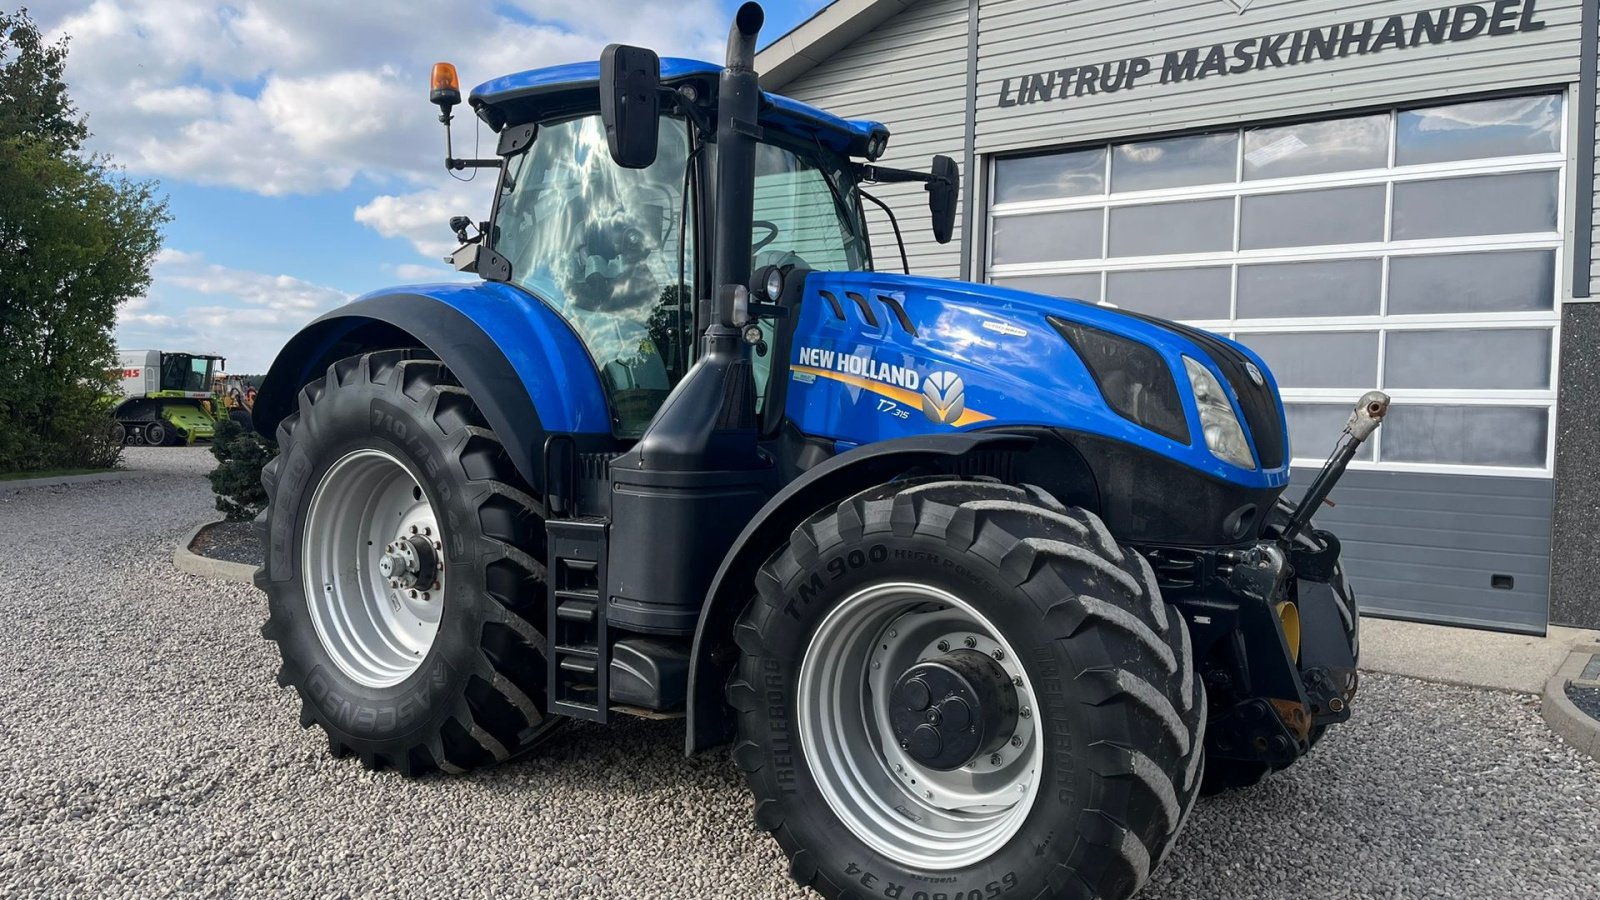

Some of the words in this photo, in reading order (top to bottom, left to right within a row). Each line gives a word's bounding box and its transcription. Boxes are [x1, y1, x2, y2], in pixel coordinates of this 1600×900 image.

[998, 57, 1150, 107] LINTRUP
[1159, 0, 1546, 84] MASKINHANDEL
[800, 346, 834, 368] NEW
[837, 353, 920, 390] HOLLAND
[826, 543, 889, 581] 900
[307, 675, 431, 732] ASCENSO
[765, 658, 797, 795] TRELLEBORG
[844, 863, 877, 888] 34
